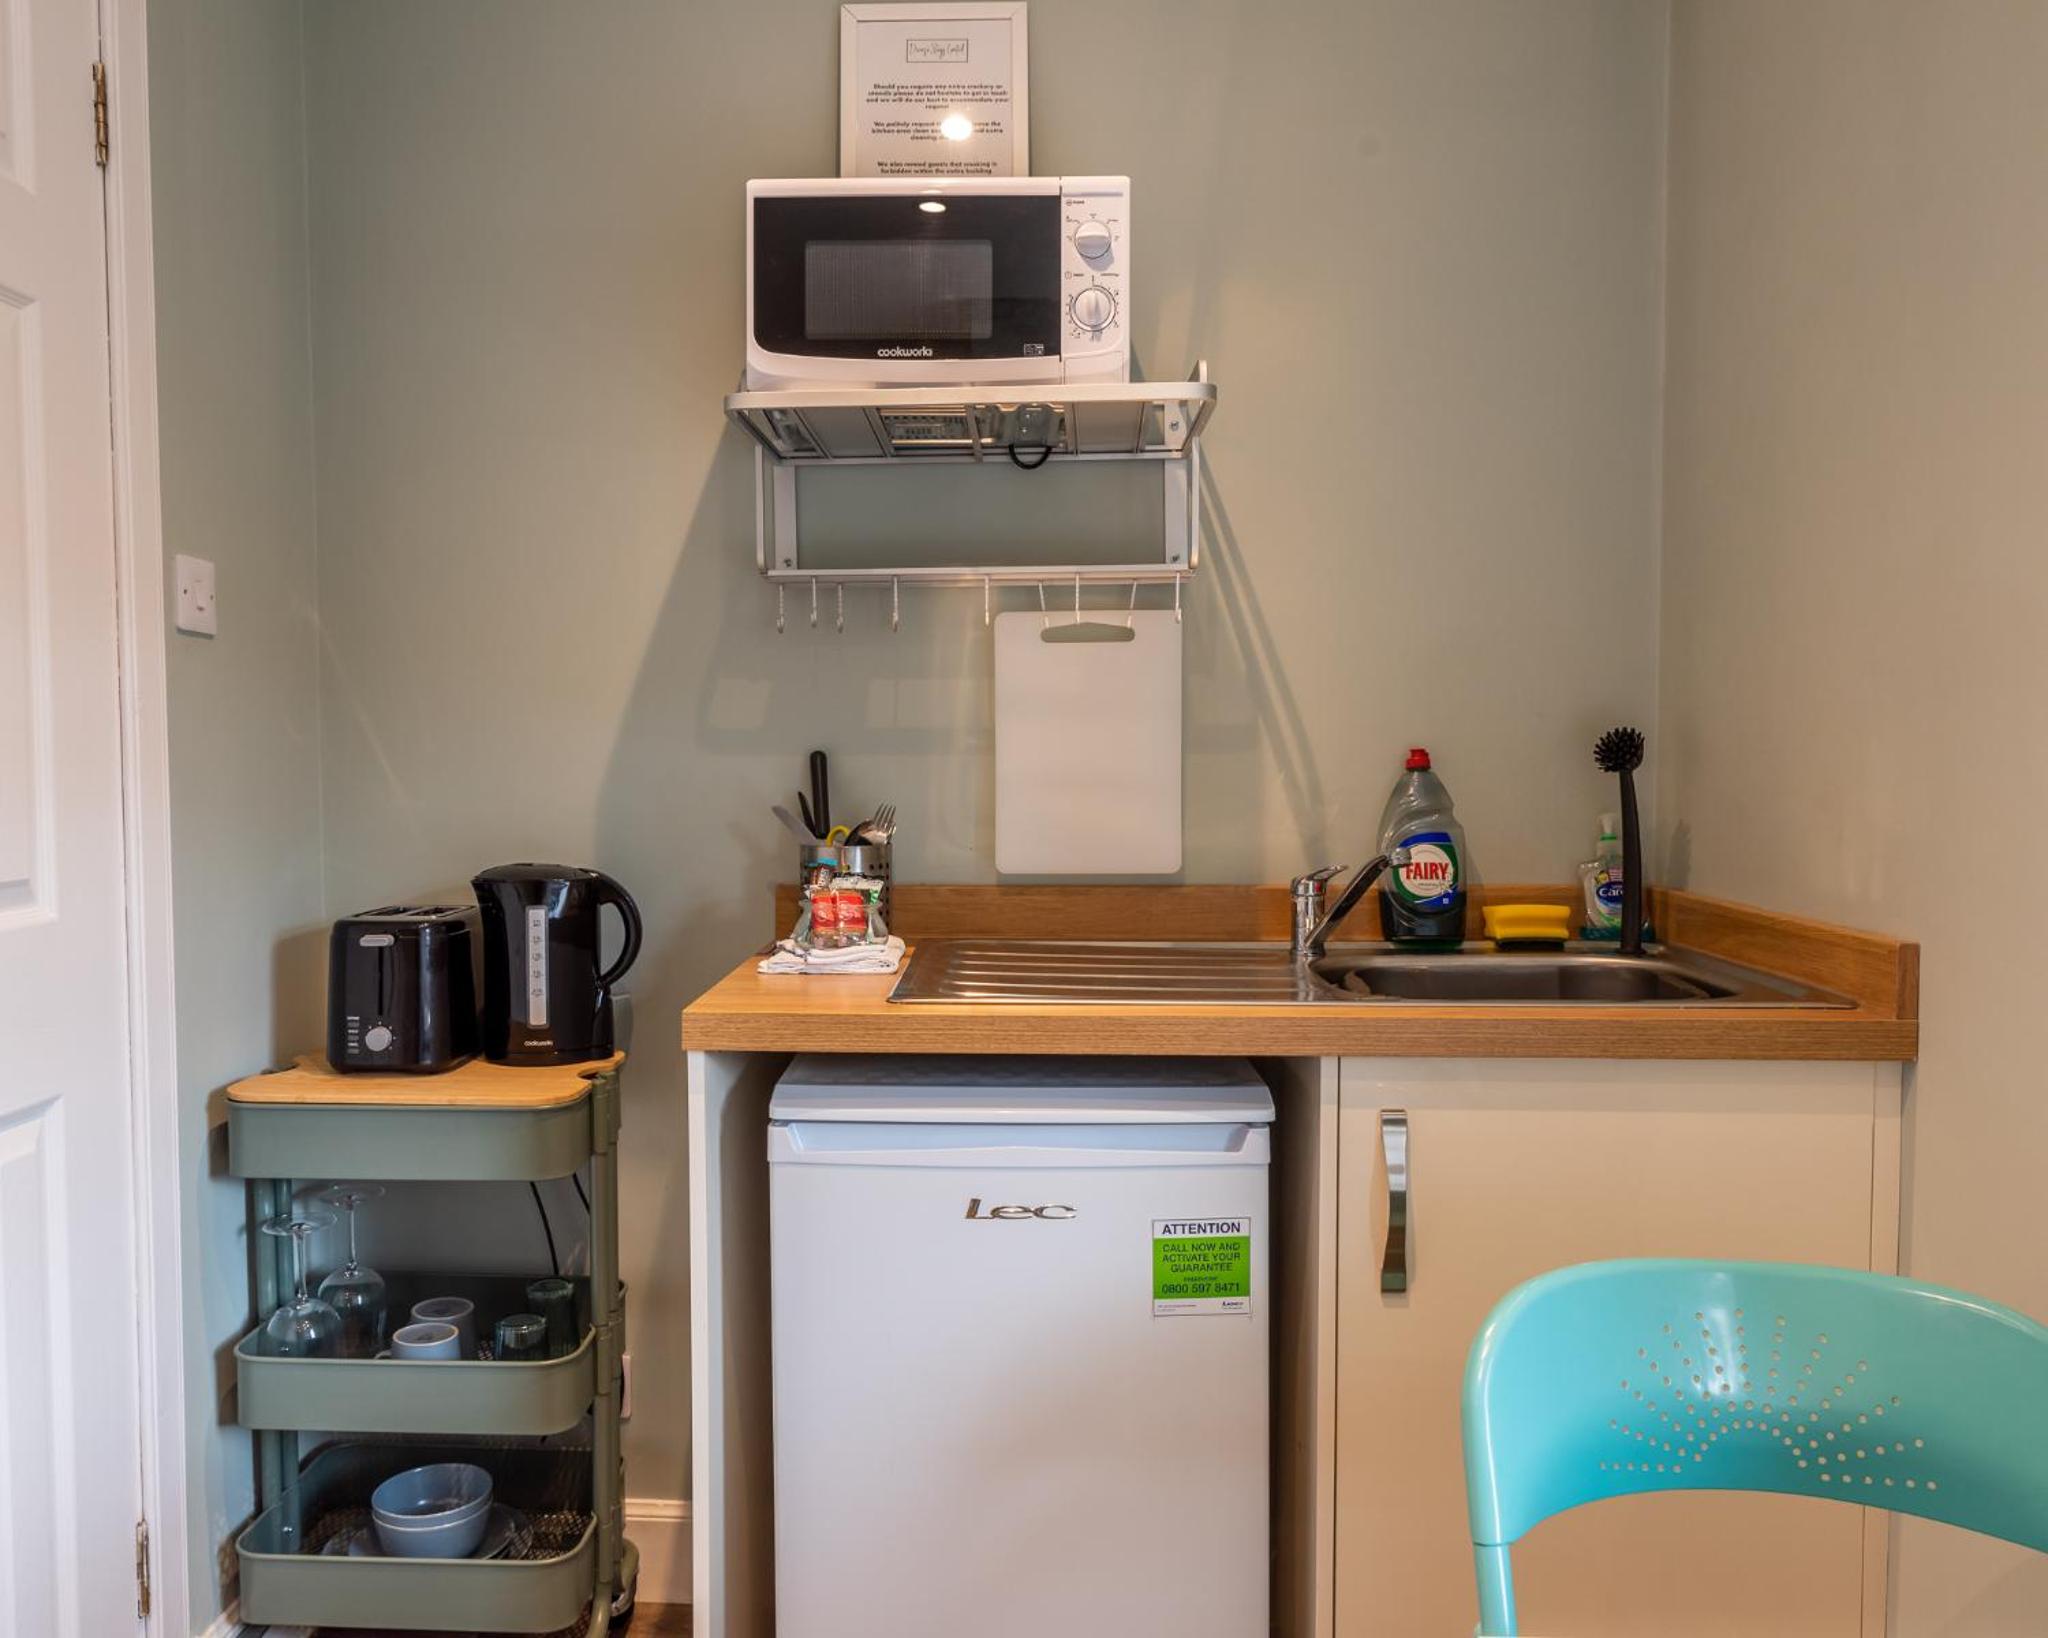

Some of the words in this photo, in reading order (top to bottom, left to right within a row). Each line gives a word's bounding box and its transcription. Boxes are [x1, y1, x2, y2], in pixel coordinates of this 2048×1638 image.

[1406, 862, 1450, 880] FAIRY
[965, 1198, 1077, 1220] Lec
[1162, 1222, 1240, 1235] ATTENTION
[1162, 1244, 1189, 1252] CALL
[1191, 1243, 1216, 1252] NOW
[1218, 1242, 1240, 1251] AND
[1162, 1253, 1208, 1263] ACTIVATE
[1213, 1252, 1240, 1261] YOUR
[1170, 1262, 1233, 1273] GUARANTEE
[1162, 1284, 1189, 1294] 0800
